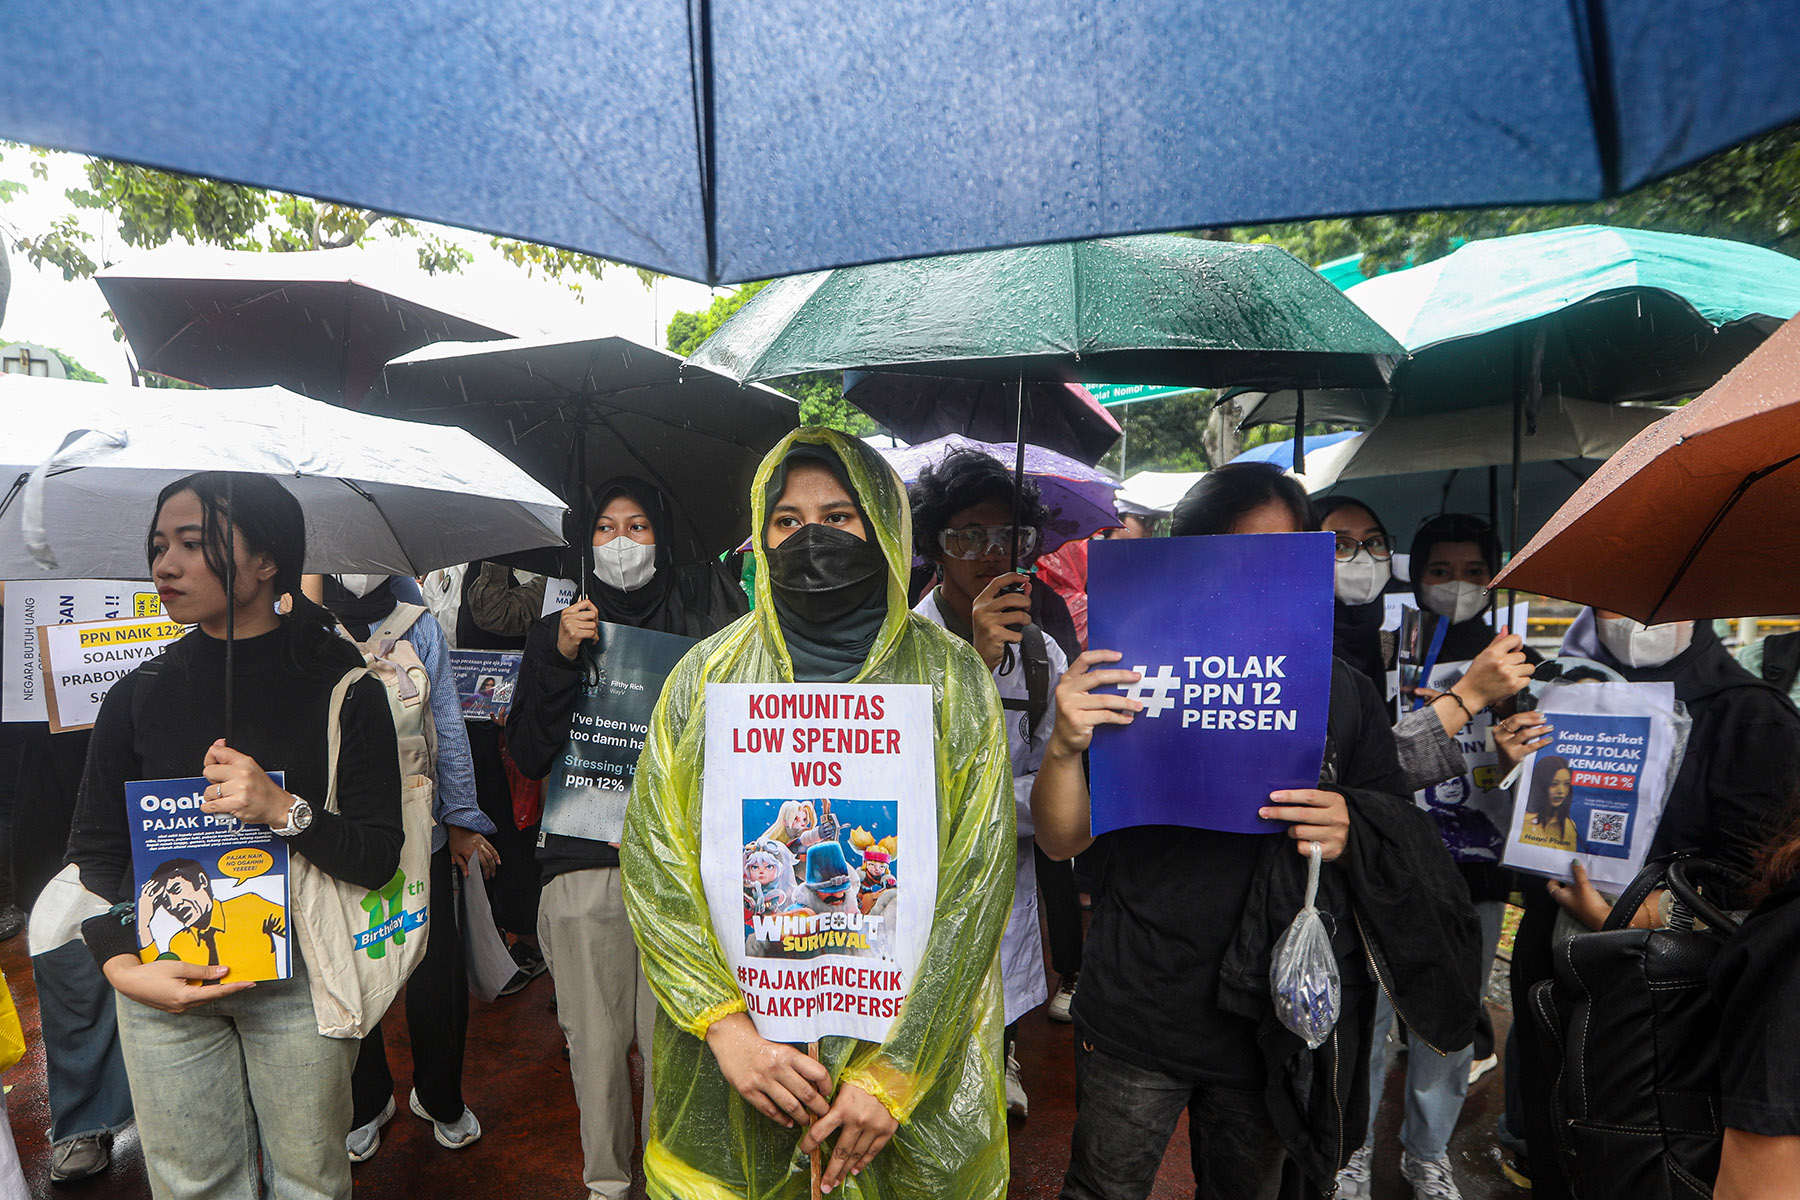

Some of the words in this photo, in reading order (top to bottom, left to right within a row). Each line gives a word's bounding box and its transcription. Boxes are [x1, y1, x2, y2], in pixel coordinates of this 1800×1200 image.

[559, 589, 575, 597] MA
[24, 597, 35, 625] UANG
[149, 595, 158, 614] 12%
[24, 628, 35, 659] BUTUH
[80, 631, 110, 644] PPN
[115, 627, 152, 641] NAIK
[156, 624, 186, 637] 12%
[83, 647, 155, 664] SOALNYA
[1183, 655, 1287, 679] TOLAK
[23, 661, 34, 701] NEGARA
[610, 680, 629, 690] Filthy
[629, 683, 644, 691] Rich
[1183, 683, 1244, 705] PPN
[1252, 682, 1282, 705] 12
[749, 694, 885, 721] KOMUNITAS
[595, 716, 627, 731] been
[1182, 709, 1298, 731] PERSEN
[569, 729, 590, 742] too
[592, 733, 628, 748] damn
[733, 728, 785, 753] LOW
[792, 728, 901, 754] SPENDER
[1558, 730, 1595, 741] Ketua
[1597, 733, 1644, 745] Serikat
[1556, 744, 1582, 755] GEN
[1583, 745, 1594, 756] Z
[1596, 746, 1642, 760] TOLAK
[564, 754, 623, 776] Stressing
[791, 761, 842, 787] WOS
[1568, 758, 1638, 773] KENAIKAN
[565, 774, 594, 789] ppn
[596, 776, 625, 792] 12%
[1574, 773, 1602, 785] PPN
[1604, 776, 1618, 787] 12
[140, 792, 205, 814] Ogah
[143, 816, 199, 831] PAJAK
[361, 915, 404, 946] Birthday
[752, 911, 884, 941] WHITEOUT
[782, 930, 871, 952] SURVIVAL
[737, 965, 903, 991] #PAJAKMENCEKIK
[741, 988, 908, 1018] TOLAKPPN12PERSE
